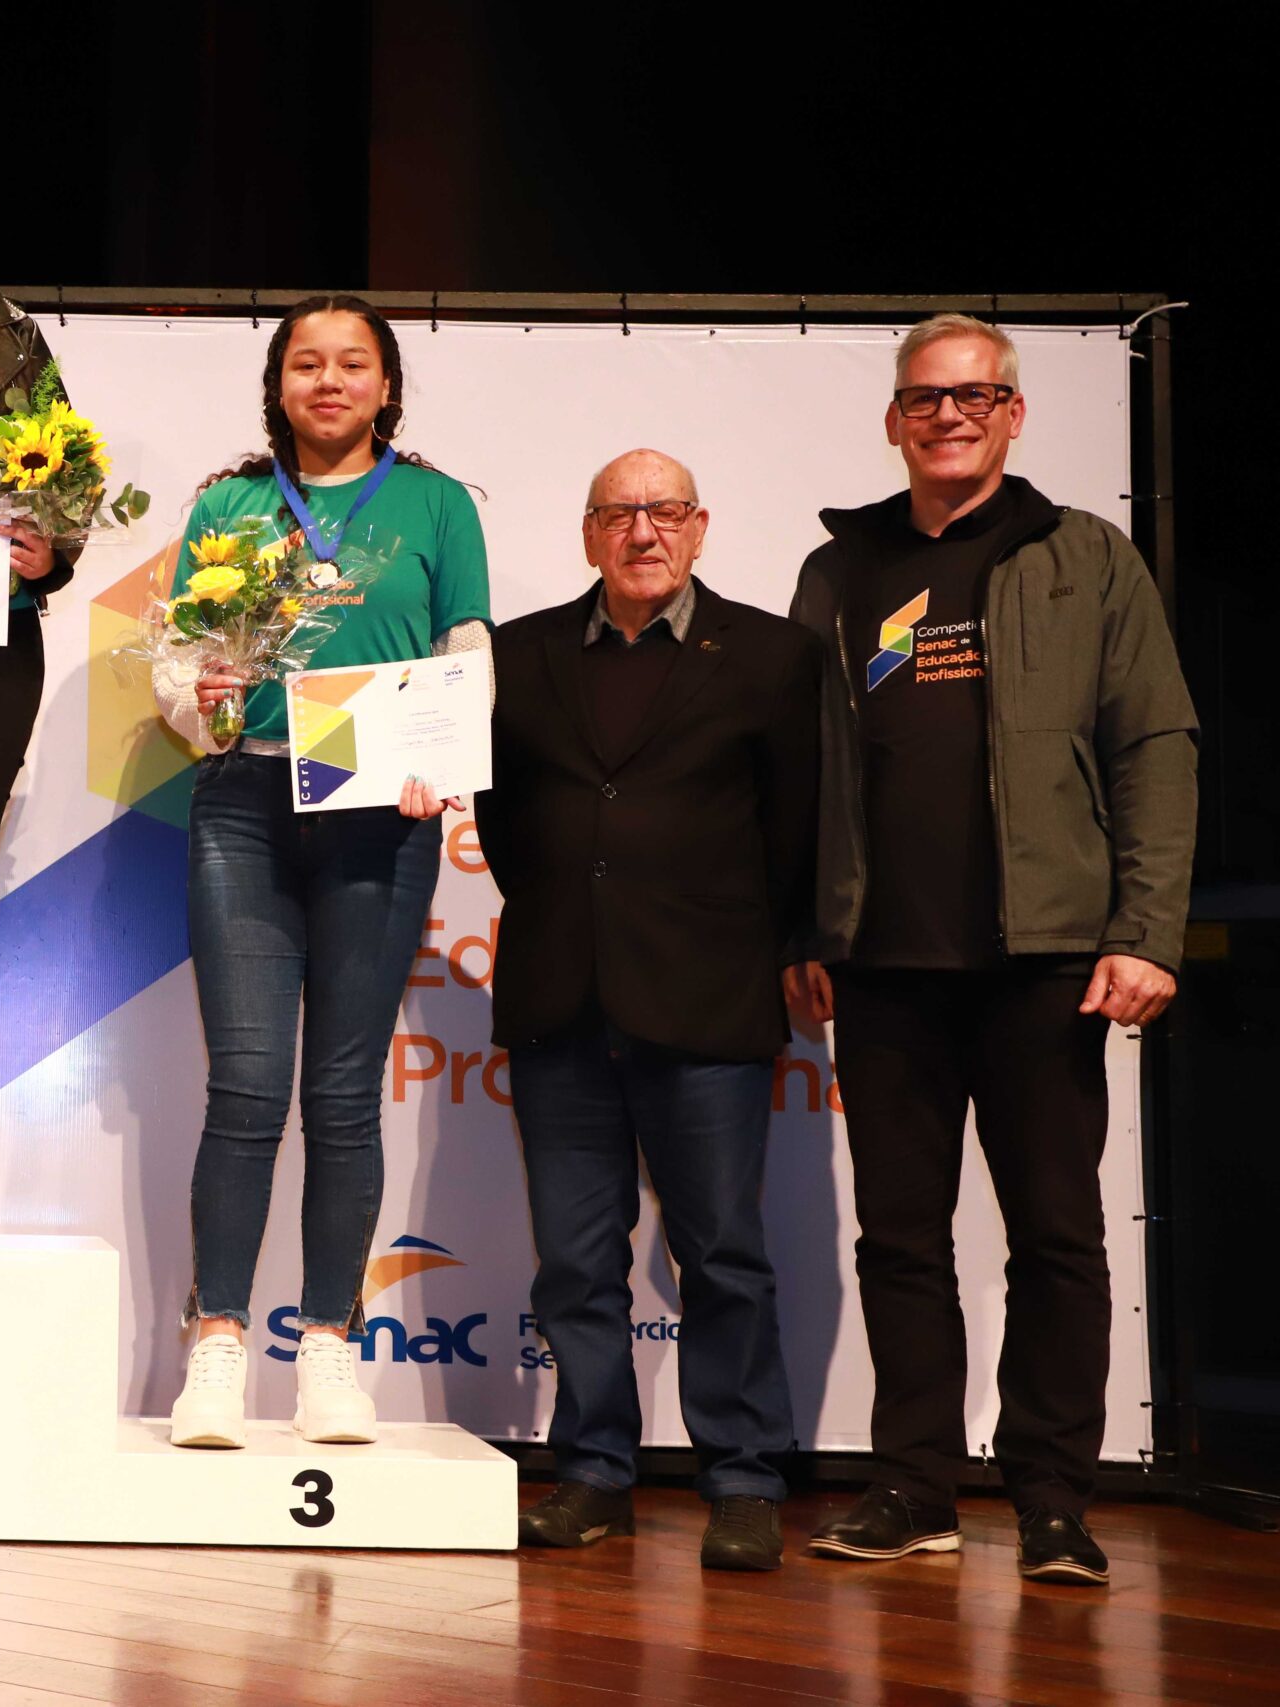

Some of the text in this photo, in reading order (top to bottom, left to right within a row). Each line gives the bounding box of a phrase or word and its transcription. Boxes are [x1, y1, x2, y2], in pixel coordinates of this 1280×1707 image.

[917, 620, 977, 637] Competi
[916, 637, 971, 652] Senac de
[916, 667, 984, 683] Profission
[265, 1305, 488, 1367] Snac
[290, 1470, 334, 1527] 3
